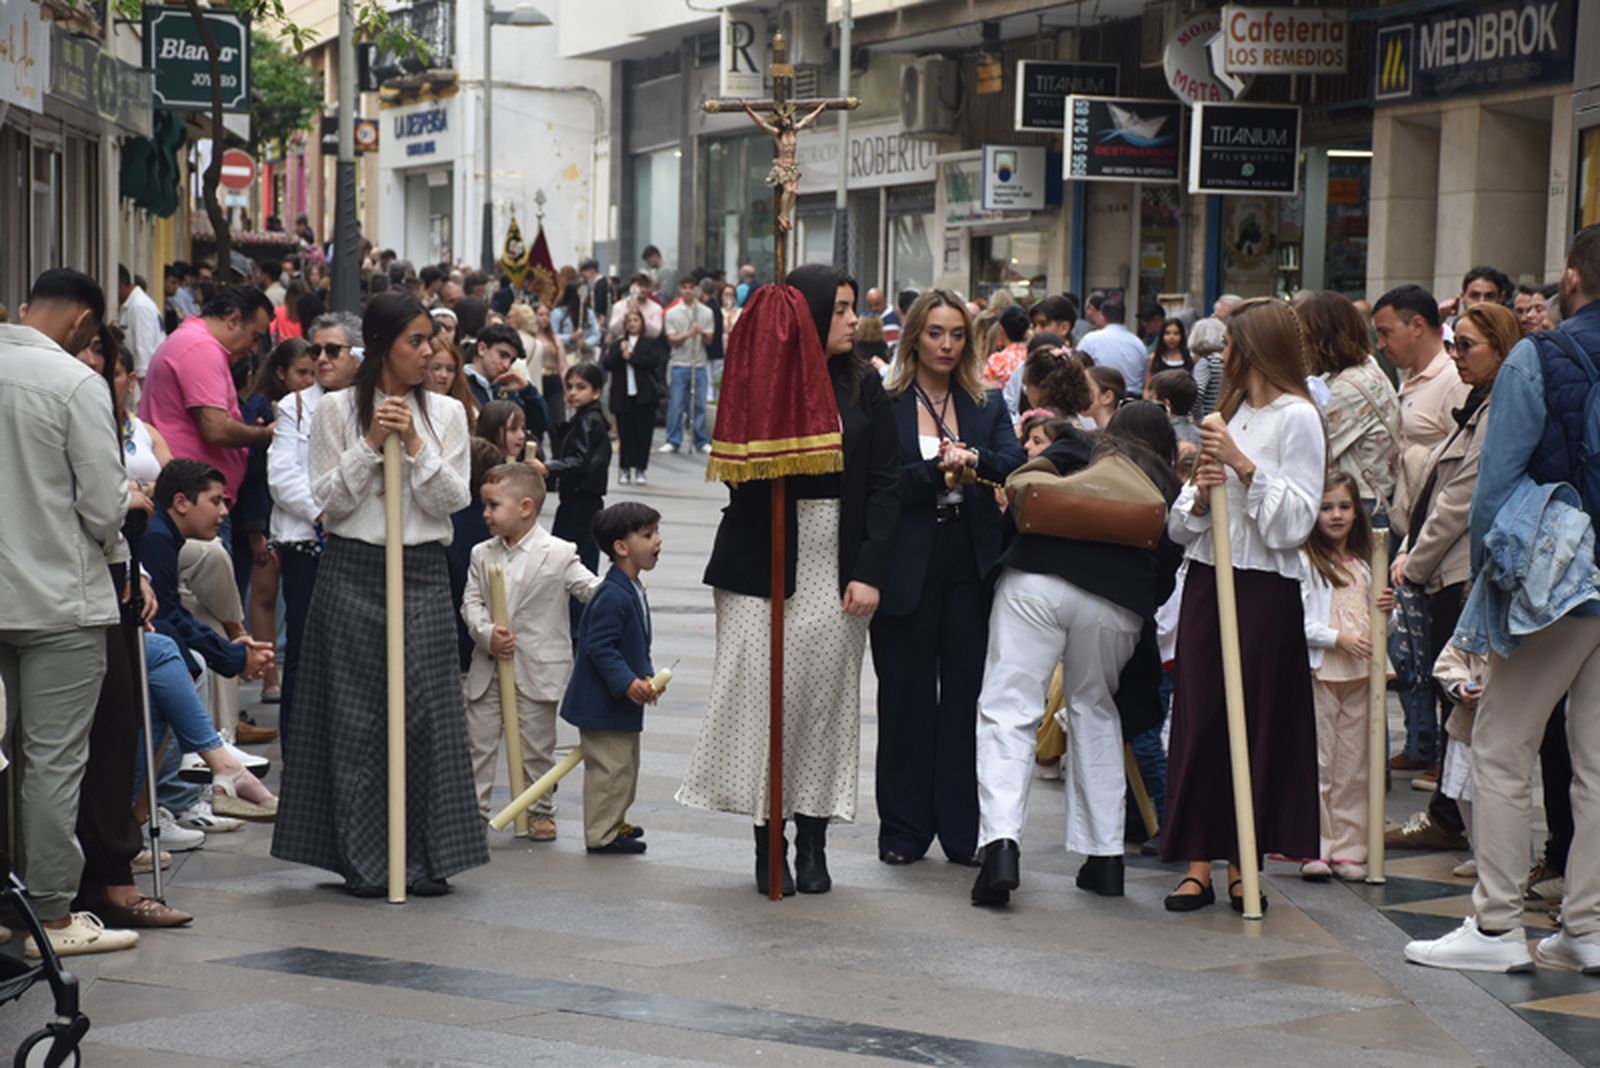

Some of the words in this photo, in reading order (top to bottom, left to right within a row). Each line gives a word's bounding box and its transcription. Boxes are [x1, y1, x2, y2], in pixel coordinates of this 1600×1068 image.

[1420, 2, 1559, 71] MEDIBROK
[159, 38, 239, 62] Blano
[728, 20, 760, 73] R
[1228, 49, 1258, 65] LOS
[1263, 48, 1344, 66] REMEDIOS
[1036, 75, 1105, 92] TITANIUM
[1173, 69, 1221, 102] MATA
[1074, 118, 1088, 133] 24
[1073, 137, 1088, 152] 51
[1211, 126, 1288, 145] TITANIUM
